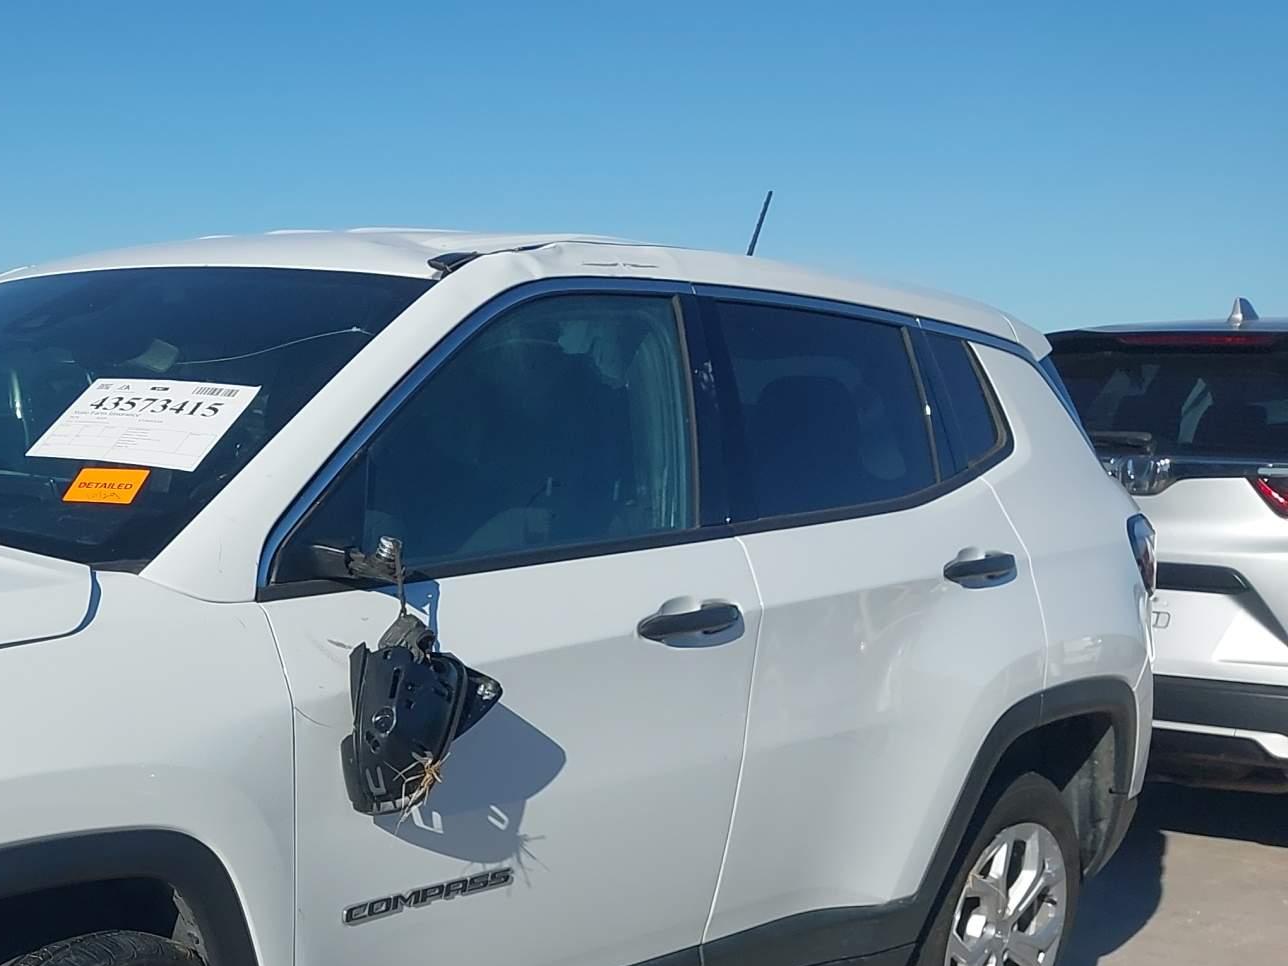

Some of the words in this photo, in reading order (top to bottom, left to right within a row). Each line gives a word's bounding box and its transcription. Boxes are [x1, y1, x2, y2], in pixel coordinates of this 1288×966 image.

[90, 396, 224, 417] 43573415
[78, 482, 133, 490] DETAILED
[342, 867, 514, 925] COMPASS
